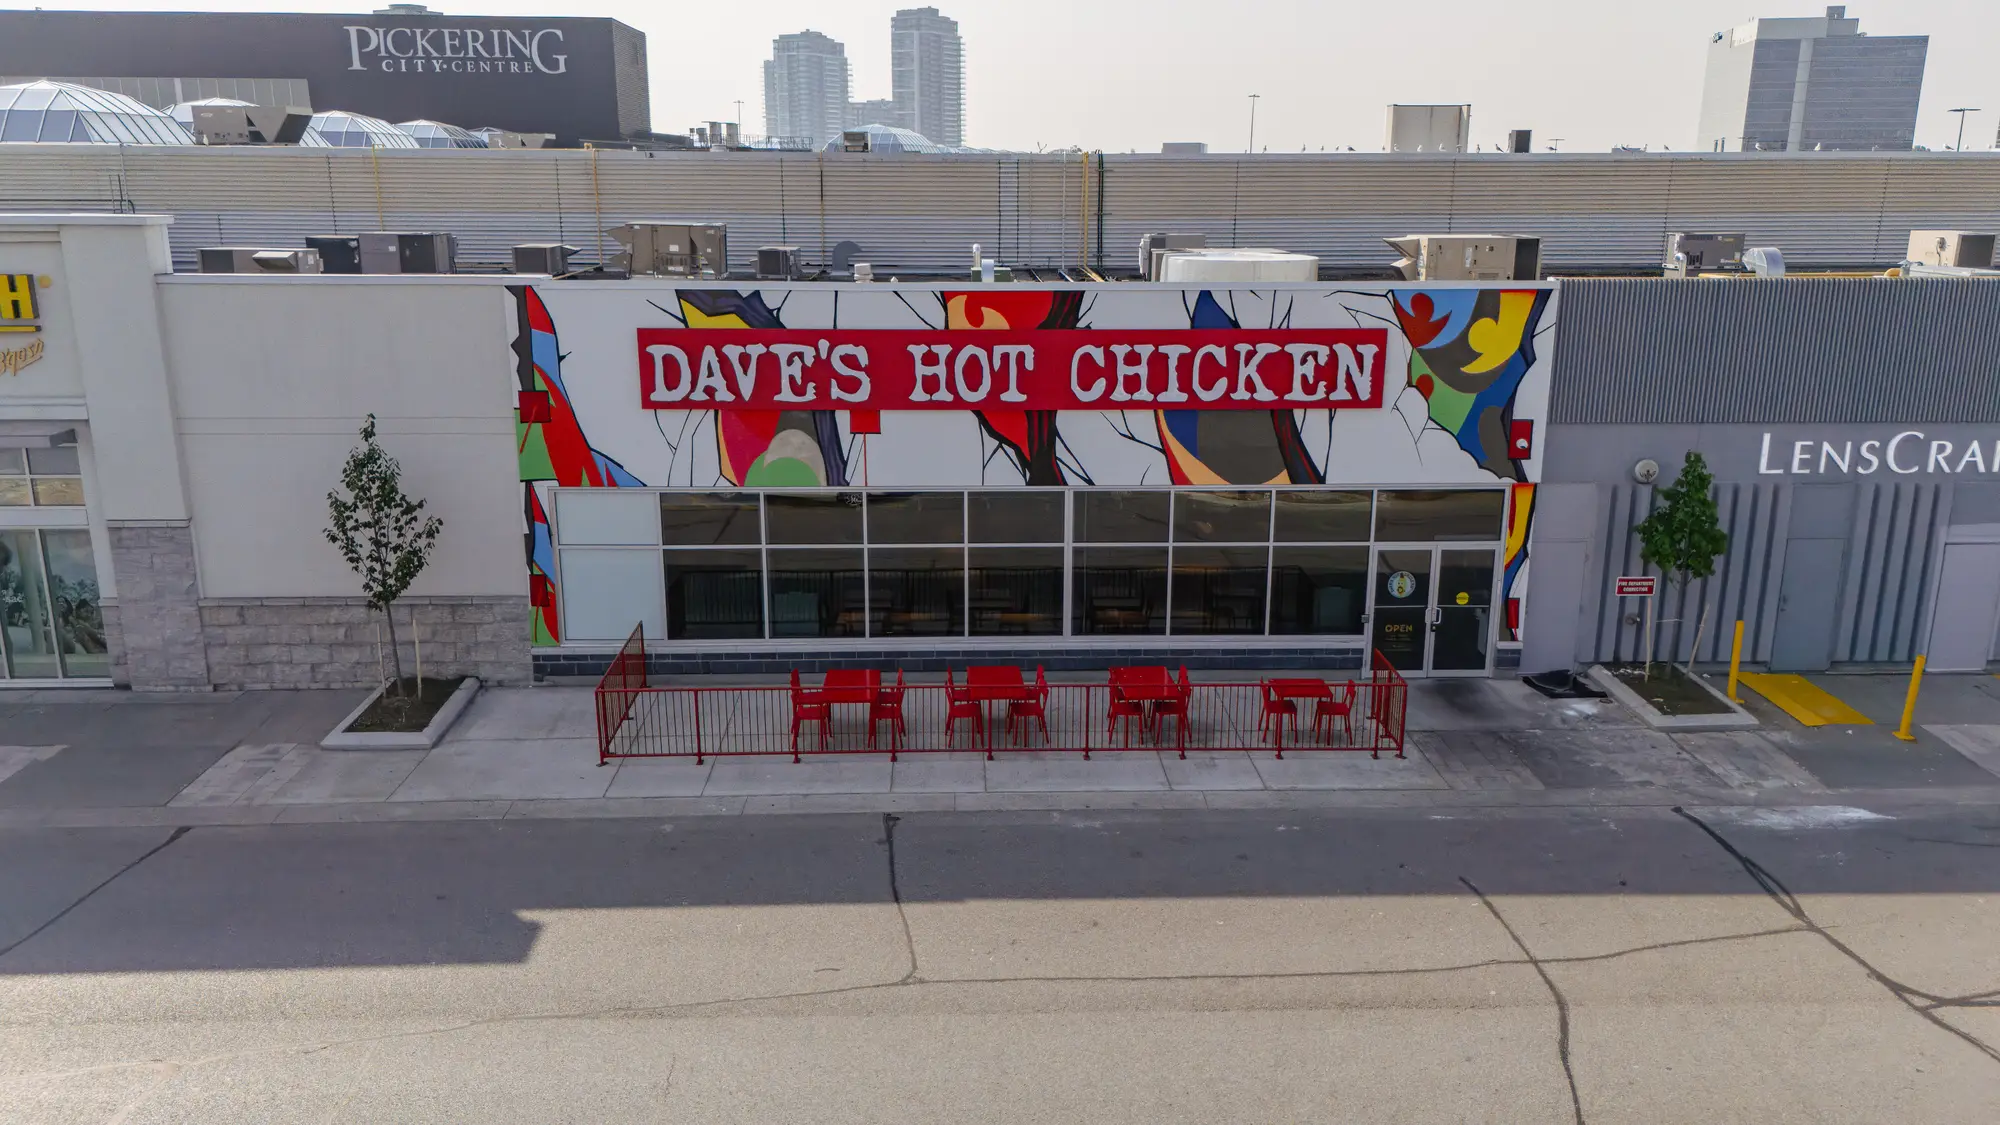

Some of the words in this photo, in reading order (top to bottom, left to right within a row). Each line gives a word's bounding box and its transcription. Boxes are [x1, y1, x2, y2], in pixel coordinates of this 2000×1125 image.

[343, 25, 568, 74] PICKERING
[381, 59, 443, 73] CITY
[451, 60, 533, 73] CENTRE
[645, 338, 872, 402] DAVE'S
[906, 343, 1035, 402] HOT
[1070, 342, 1380, 402] CHICKEN
[1758, 431, 2000, 474] LENSCRA
[1384, 624, 1413, 633] OPEN
